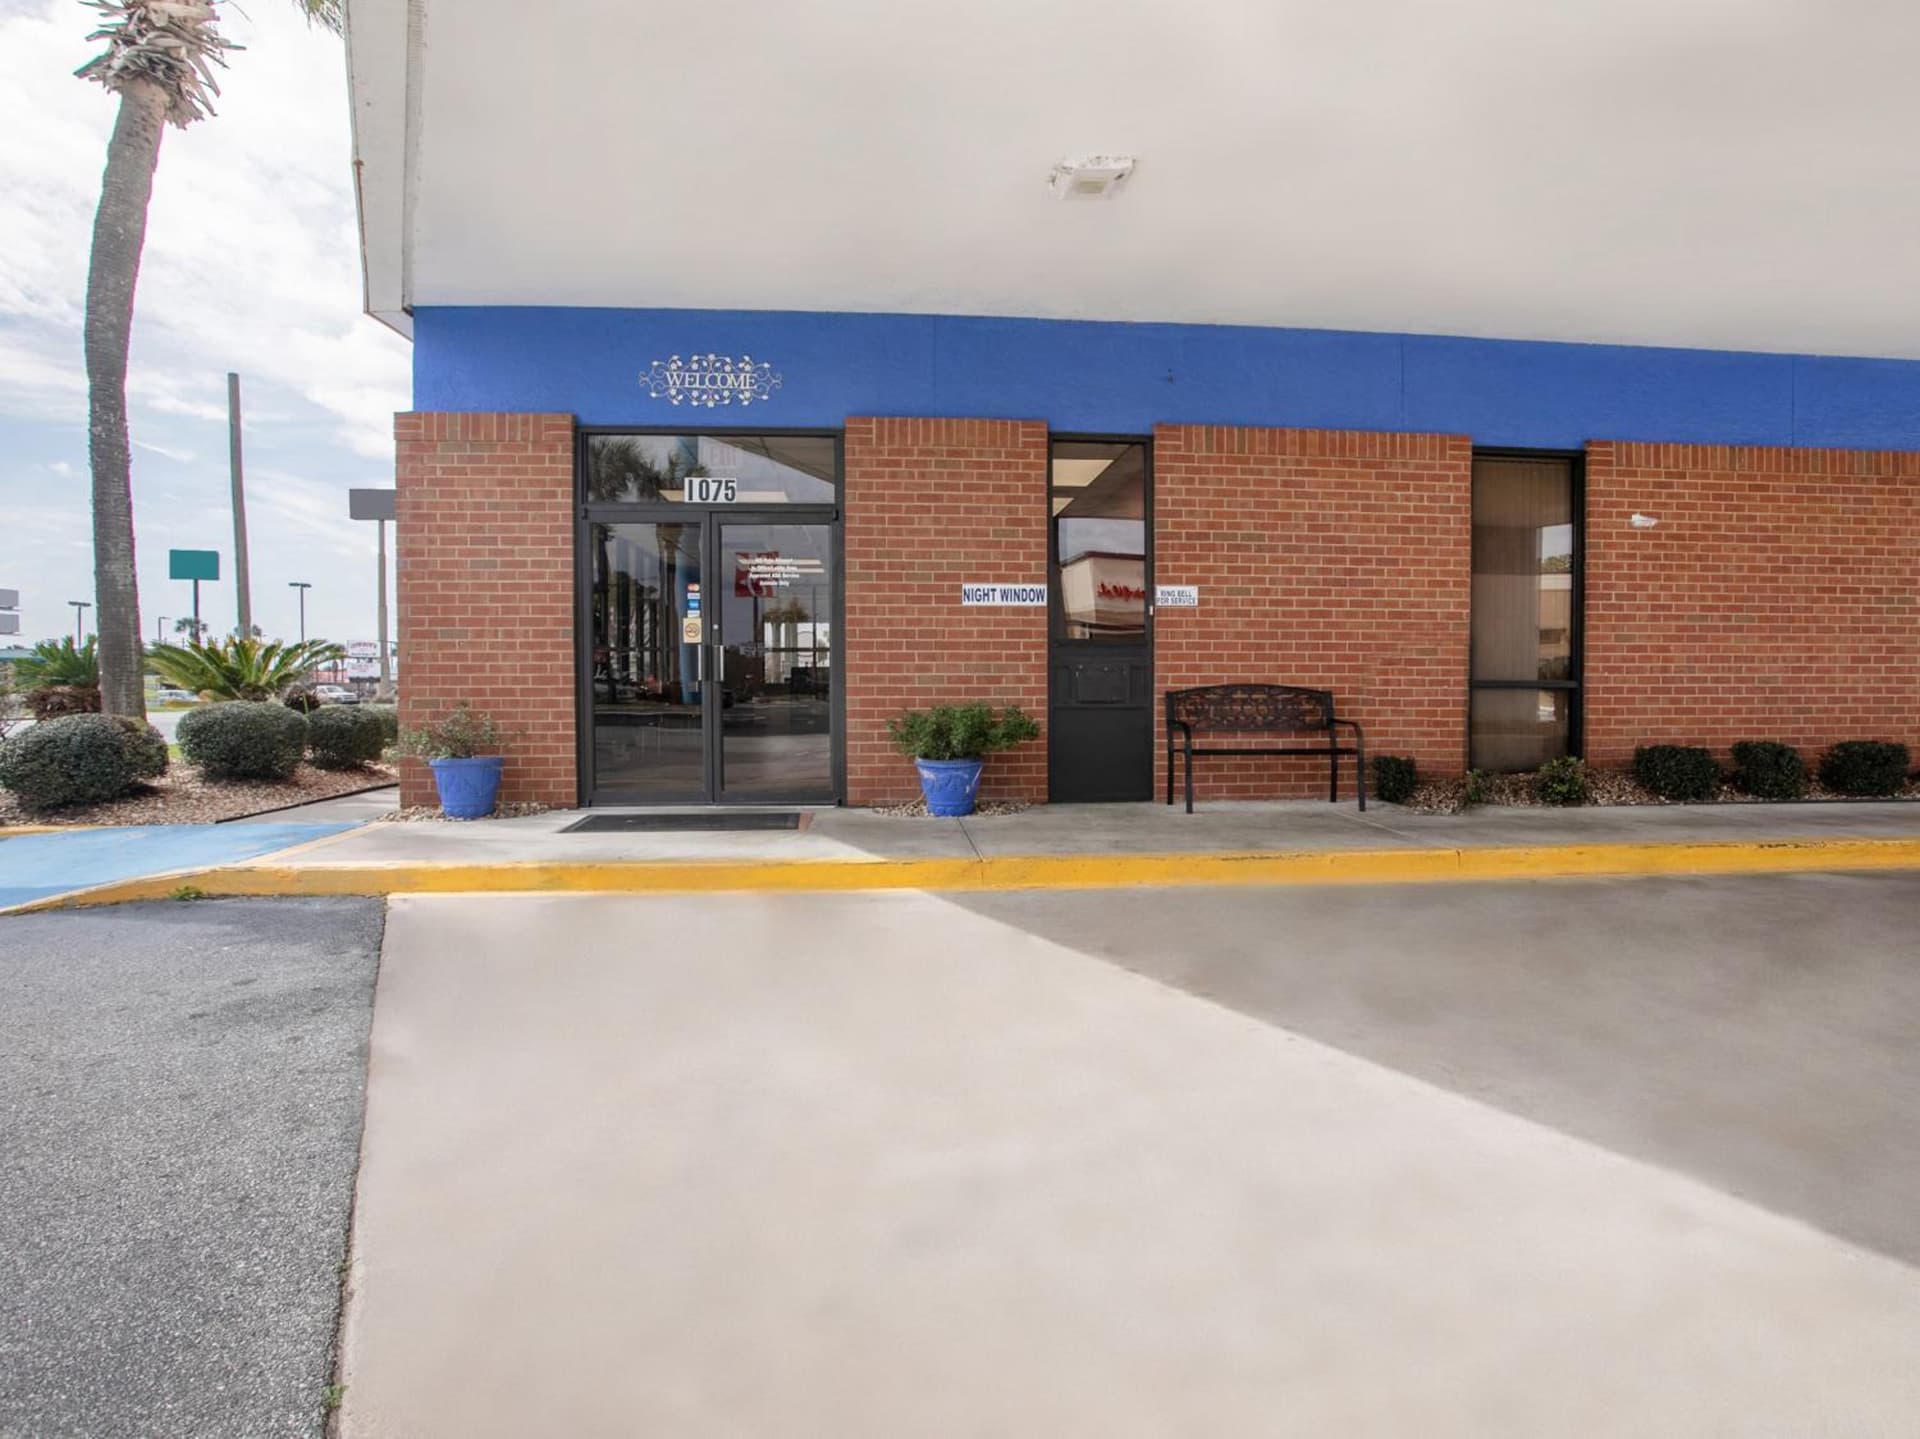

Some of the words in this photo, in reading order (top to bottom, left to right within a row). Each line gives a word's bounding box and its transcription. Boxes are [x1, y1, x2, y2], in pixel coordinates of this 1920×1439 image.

[664, 371, 757, 390] WELCOME
[688, 479, 735, 501] 1075
[963, 588, 997, 602] NIGHT
[999, 588, 1045, 602] WINDOW
[1177, 589, 1192, 597] BELL
